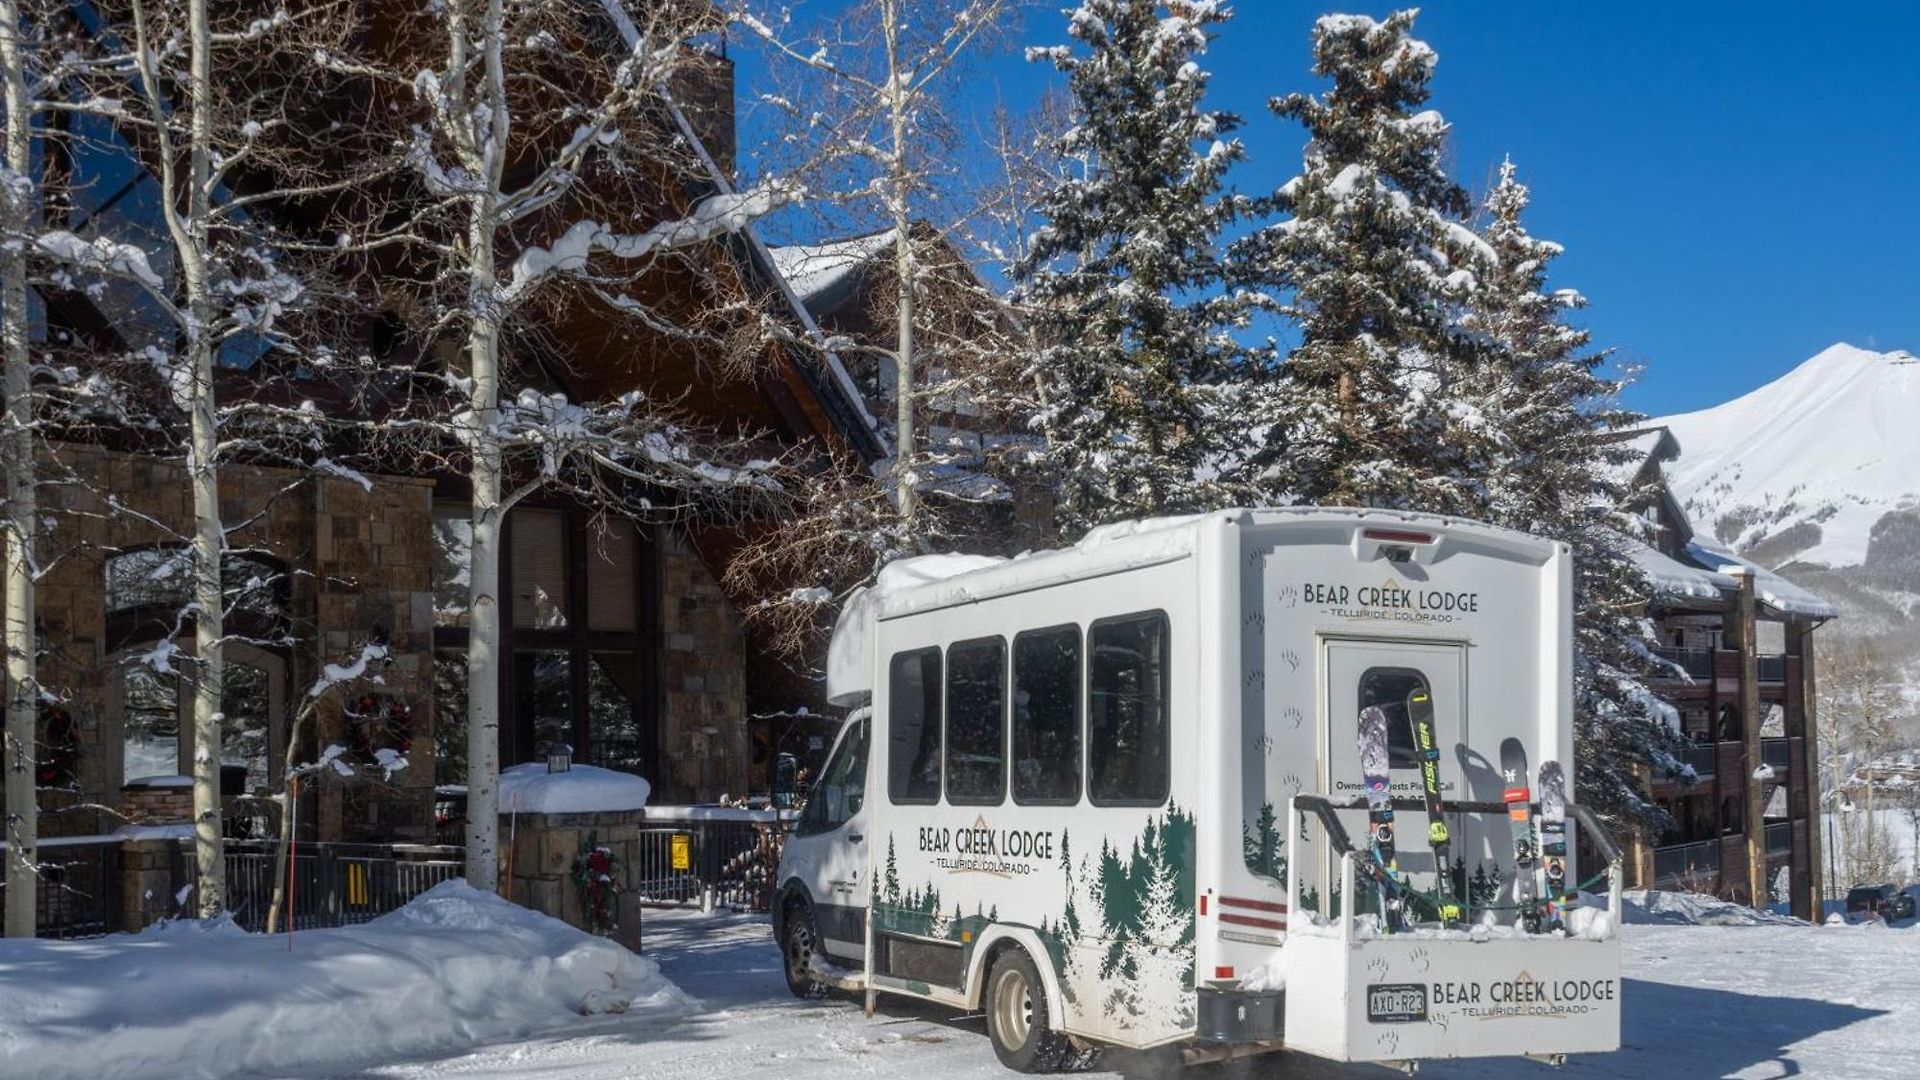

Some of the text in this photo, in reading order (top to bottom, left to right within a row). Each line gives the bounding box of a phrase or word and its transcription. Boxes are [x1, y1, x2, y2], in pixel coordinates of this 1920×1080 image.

[1304, 583, 1478, 612] BEAR CREEK LODGE
[1394, 611, 1453, 622] COLORADO
[1419, 722, 1438, 794] FISCER
[1336, 781, 1367, 790] Owner
[919, 827, 1053, 860] BEAR CREEK LODGE
[982, 861, 1030, 875] COLORADO
[1433, 980, 1614, 1004] BEAR CREEK LODGE
[1528, 1005, 1589, 1016] COLORADO
